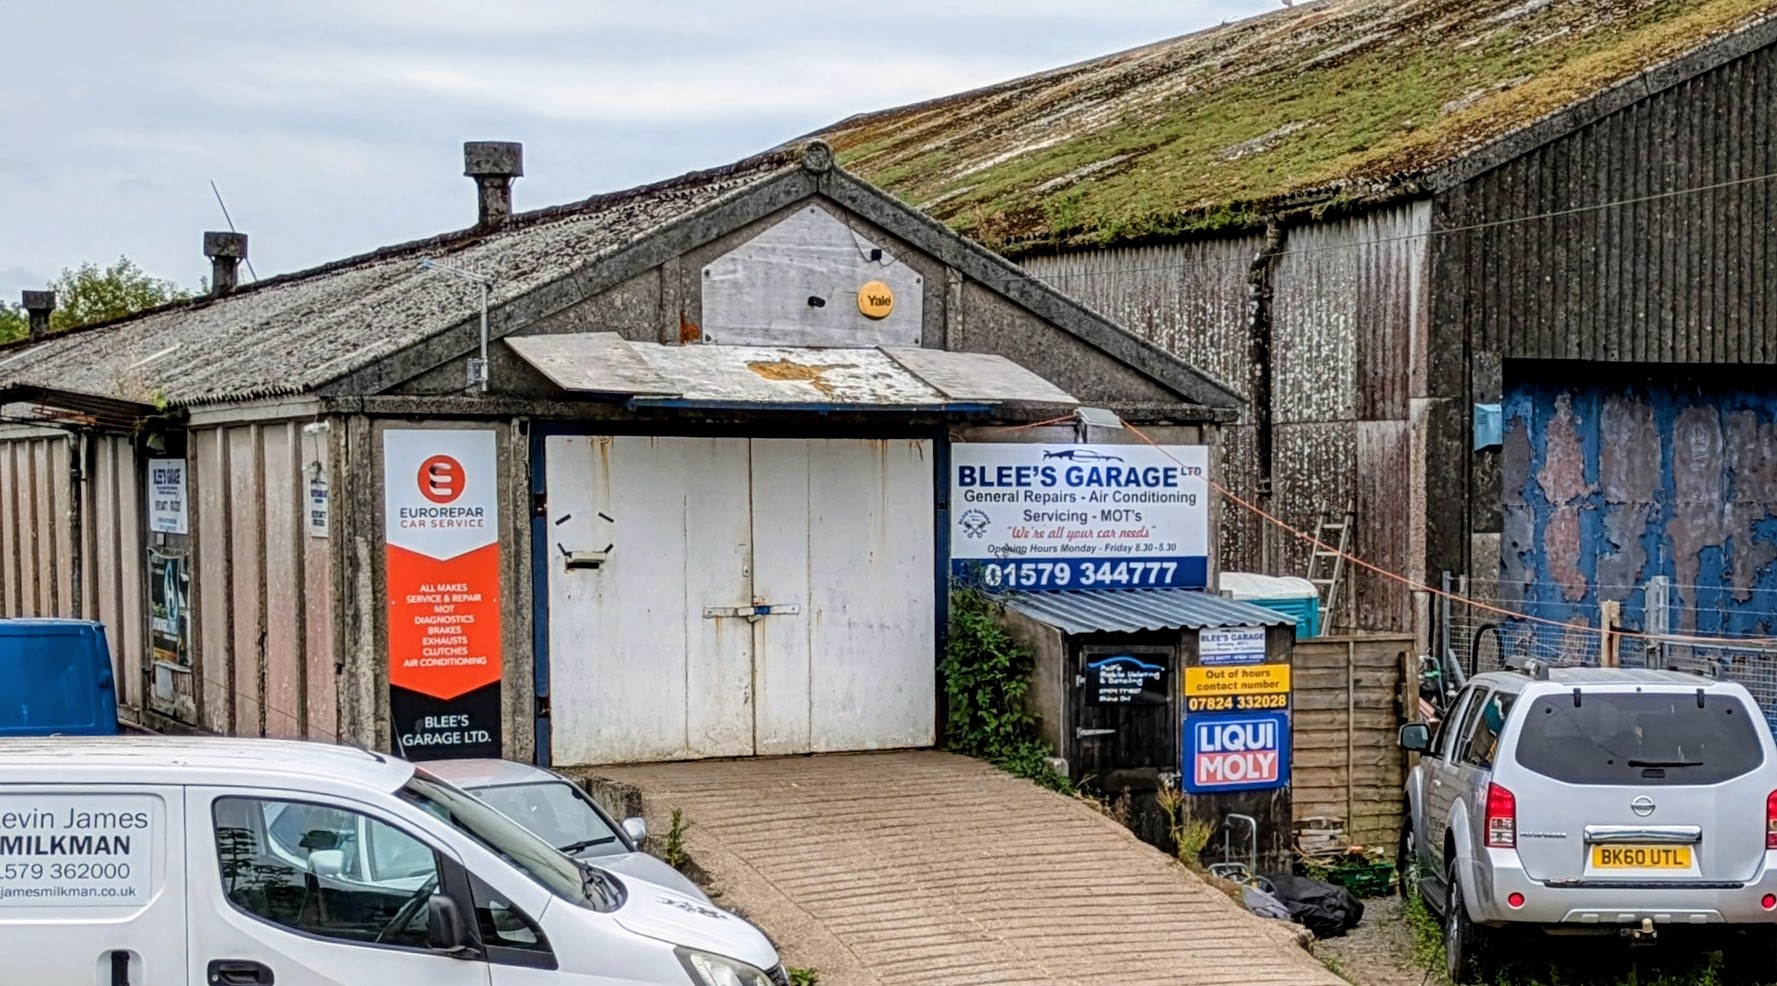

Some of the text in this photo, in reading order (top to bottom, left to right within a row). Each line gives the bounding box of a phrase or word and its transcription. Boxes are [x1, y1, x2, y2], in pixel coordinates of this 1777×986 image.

[867, 295, 891, 306] Yale
[958, 466, 1202, 487] BLEE'S GARAGE LTD
[964, 490, 1019, 502] General
[1024, 490, 1077, 505] Repairs
[1089, 490, 1109, 503] Air
[1112, 490, 1197, 506] Conditioning
[400, 507, 484, 518] EUROREPAR
[1023, 510, 1088, 525] Servicing
[1101, 509, 1142, 522] MOT's
[400, 519, 484, 528] CAR SERVICE
[1049, 526, 1064, 539] all
[1067, 528, 1094, 542] your
[1097, 529, 1116, 539] car
[1030, 544, 1058, 553] Hours
[1061, 544, 1097, 555] Monday
[1105, 543, 1132, 554] Friday
[985, 562, 1177, 587] 01579 344777
[420, 584, 468, 592] ALL MAKES
[406, 594, 482, 604] SERVICE & REPAIR
[434, 605, 455, 613] MOT
[414, 615, 475, 624] DIAGNOSTICS
[428, 626, 462, 634] BRAKES
[422, 637, 468, 645] EXHAUSTS
[1201, 633, 1264, 642] BLEE'S GARAGE
[423, 647, 468, 656] CLUTCHES
[403, 657, 487, 667] AIR CONDITIONING
[1206, 669, 1271, 679] Out of hours
[1197, 680, 1279, 691] contact number
[1189, 695, 1287, 711] 07824 332028
[424, 715, 469, 728] BLEE'S
[402, 731, 492, 746] GARAGE LTD.
[1200, 723, 1274, 752] LIQUI
[1200, 753, 1276, 782] MOLY
[0, 808, 148, 829] evin James
[0, 835, 131, 856] MILKMAN
[1601, 849, 1684, 866] BK60 UTL
[50, 863, 130, 880] 362000
